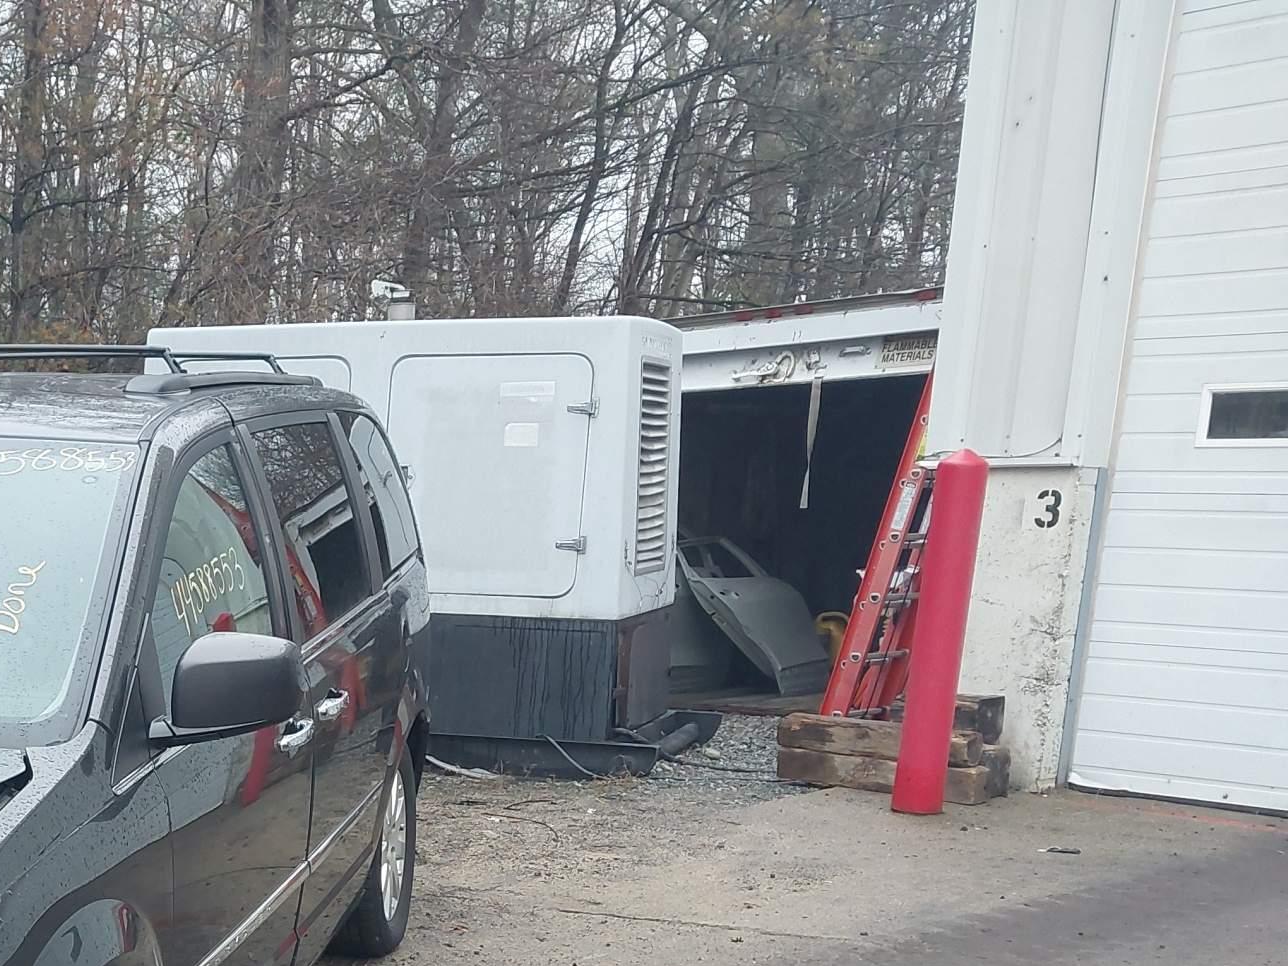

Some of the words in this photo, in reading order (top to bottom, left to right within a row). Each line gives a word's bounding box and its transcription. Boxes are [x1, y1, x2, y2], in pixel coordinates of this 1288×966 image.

[881, 349, 934, 363] MATERIALS
[1034, 489, 1062, 528] 3
[170, 547, 245, 637] 44588553
